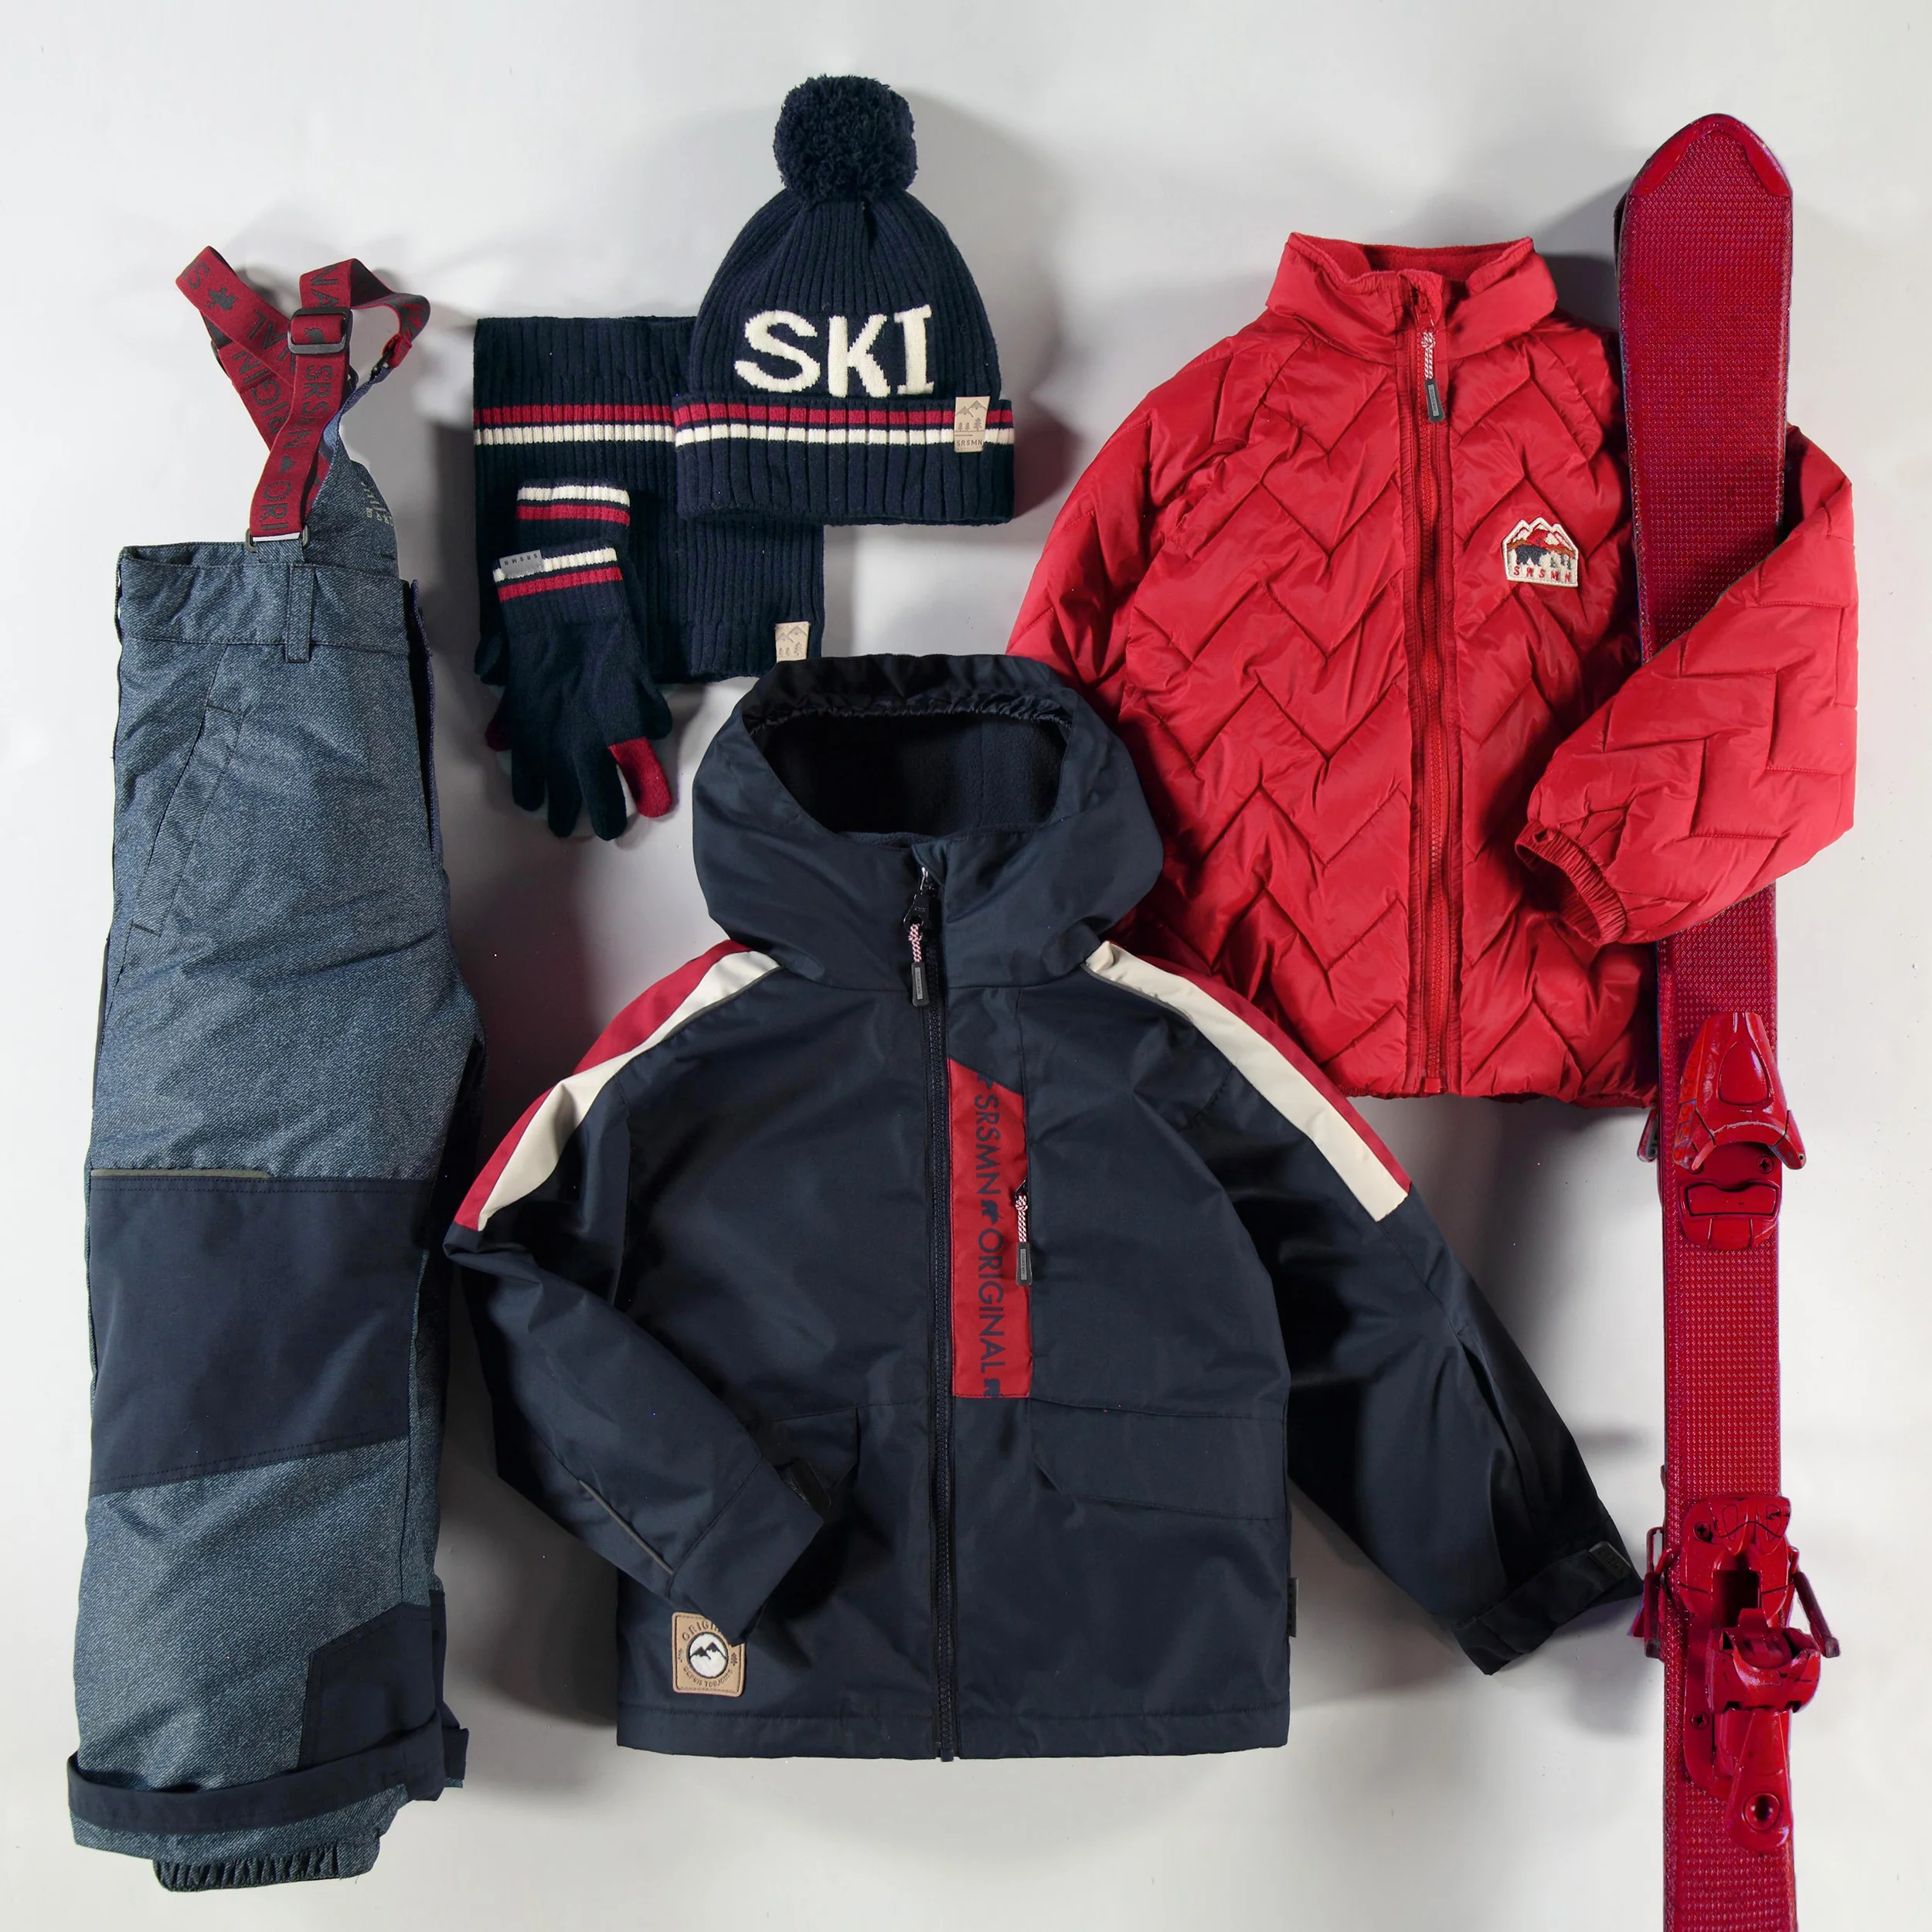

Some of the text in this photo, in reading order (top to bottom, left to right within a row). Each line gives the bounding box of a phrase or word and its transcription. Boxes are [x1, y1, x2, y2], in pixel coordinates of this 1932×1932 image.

[734, 304, 935, 398] SKI
[504, 553, 538, 566] SRSMN
[1513, 566, 1571, 583] SRSMN
[974, 1094, 1005, 1373] SRSMN ORIGINAL
